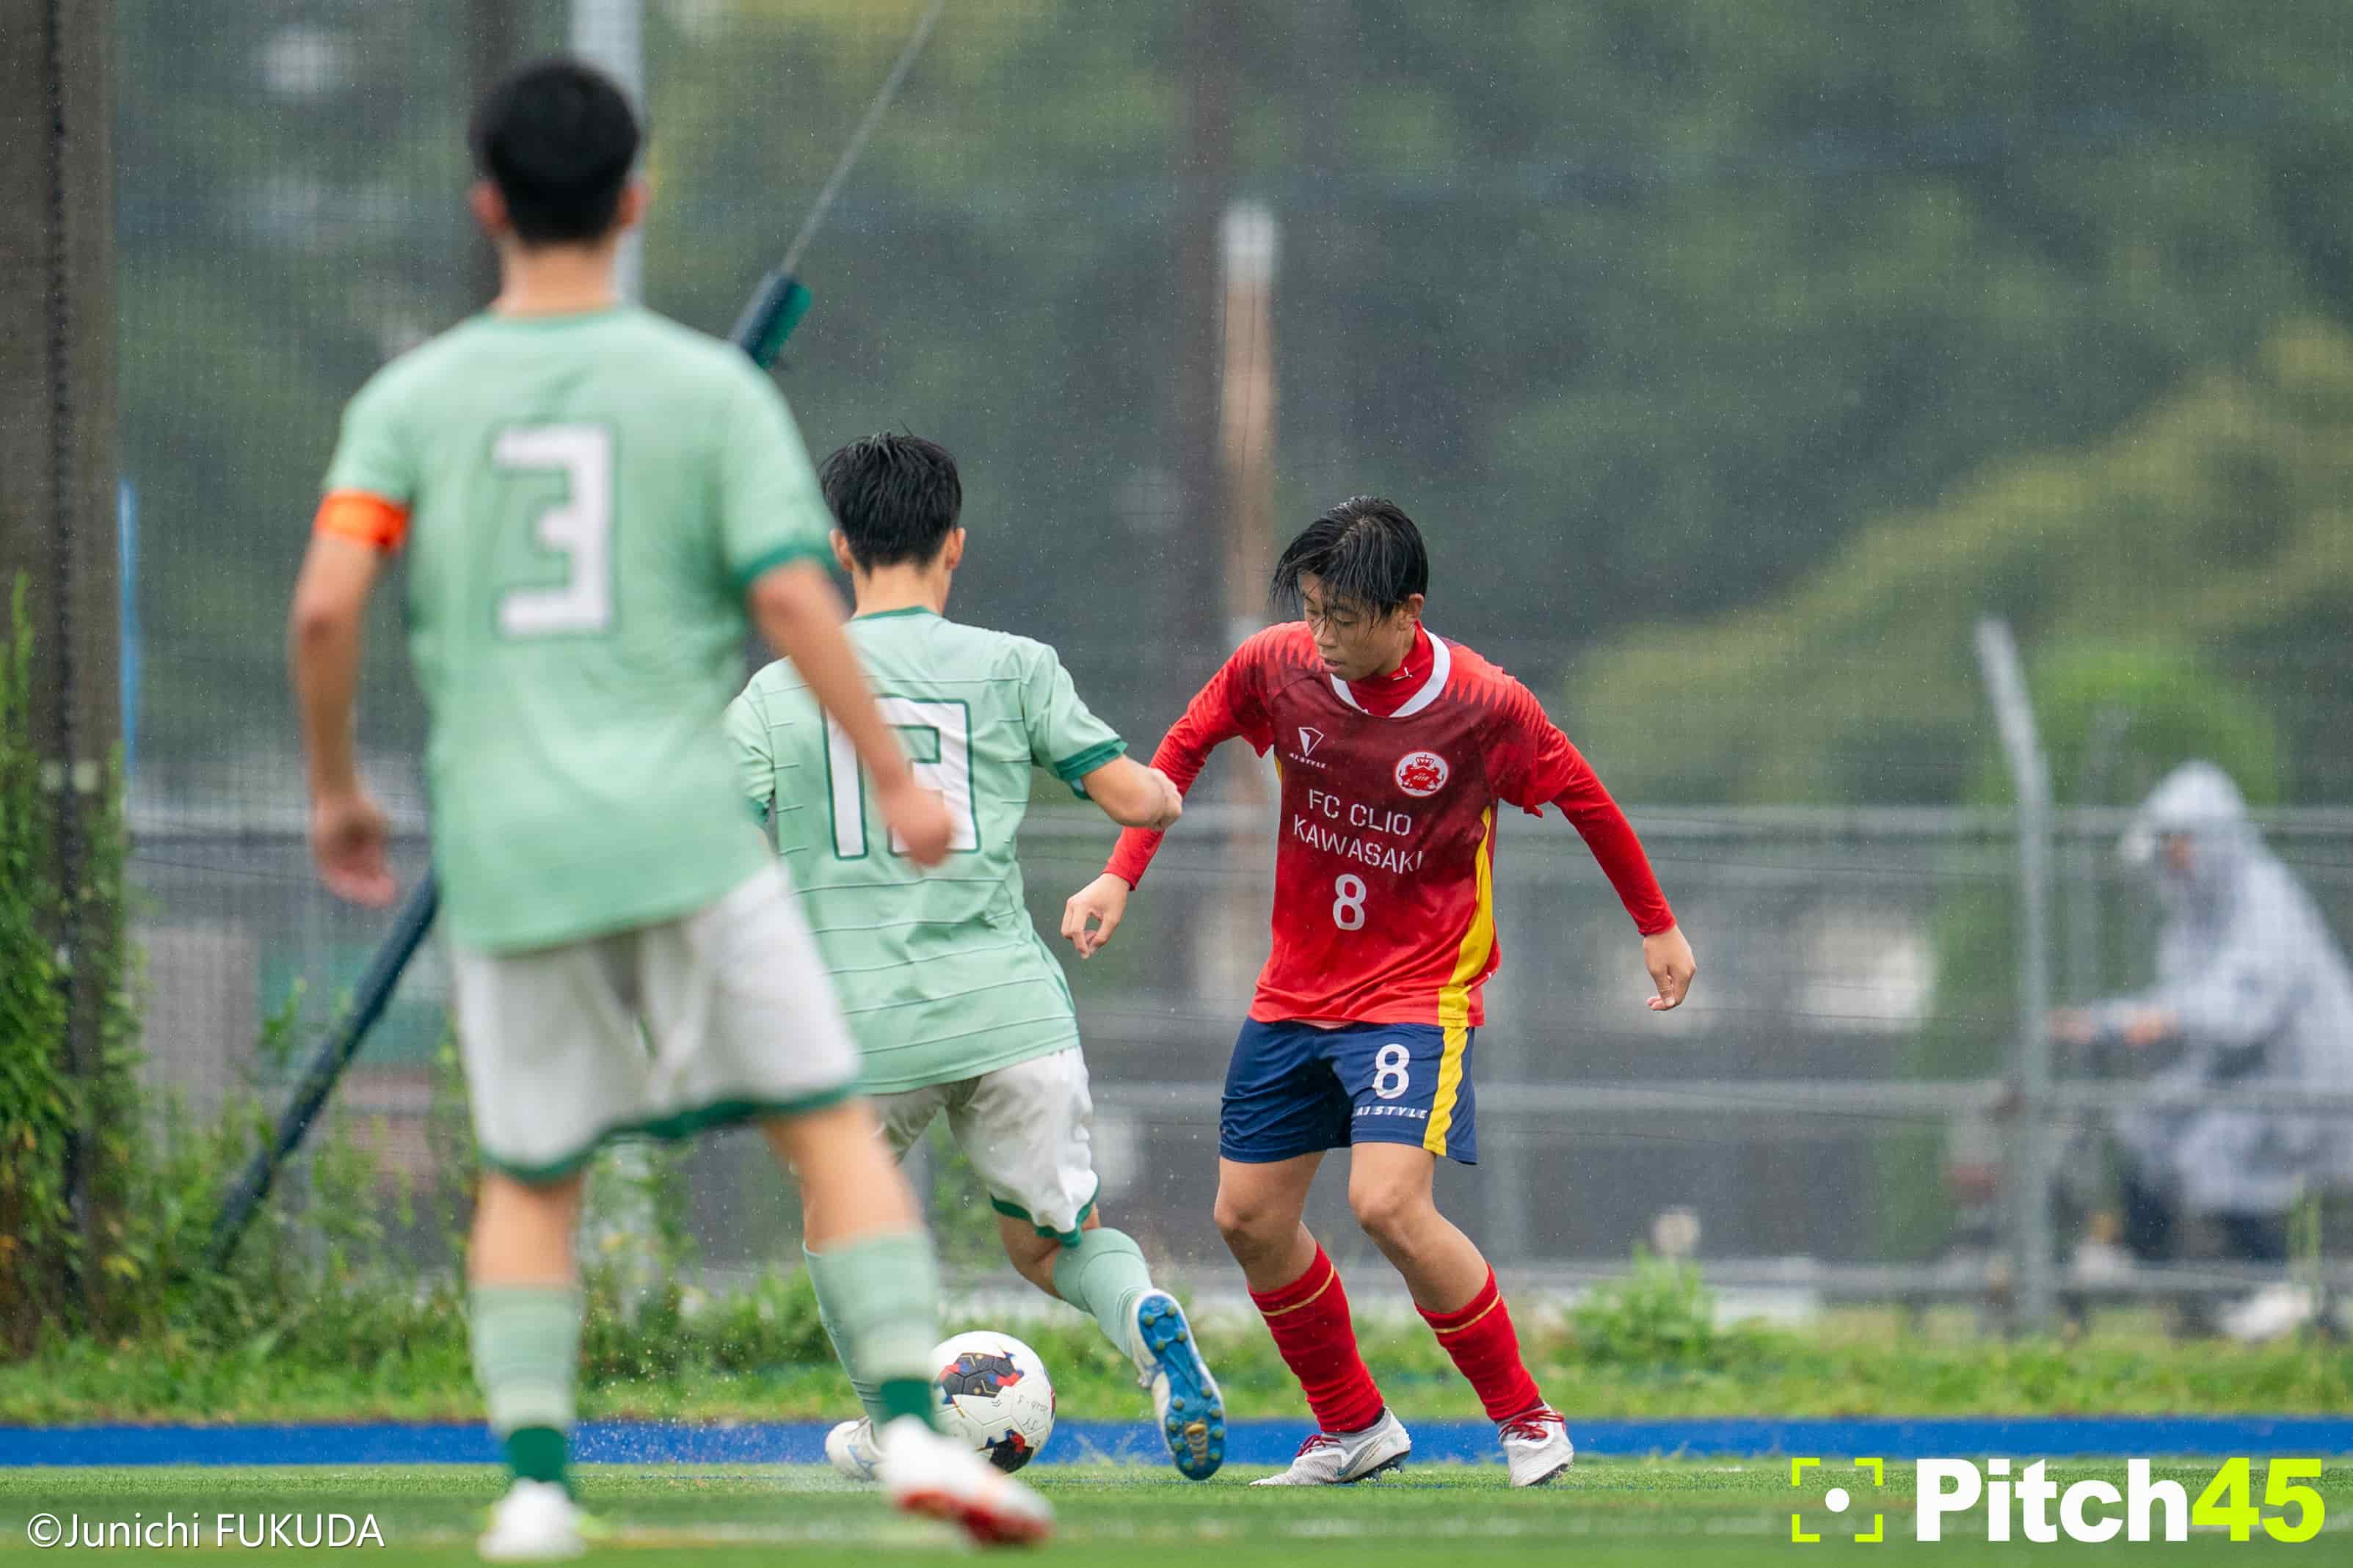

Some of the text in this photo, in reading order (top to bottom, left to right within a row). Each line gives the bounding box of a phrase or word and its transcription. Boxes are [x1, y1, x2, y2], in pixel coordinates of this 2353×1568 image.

[492, 422, 613, 635] 3
[1309, 788, 1412, 836] FC CLIO
[1292, 814, 1422, 874] KAWASAKI
[1333, 874, 1367, 930] 8
[1372, 1043, 1410, 1099] 8
